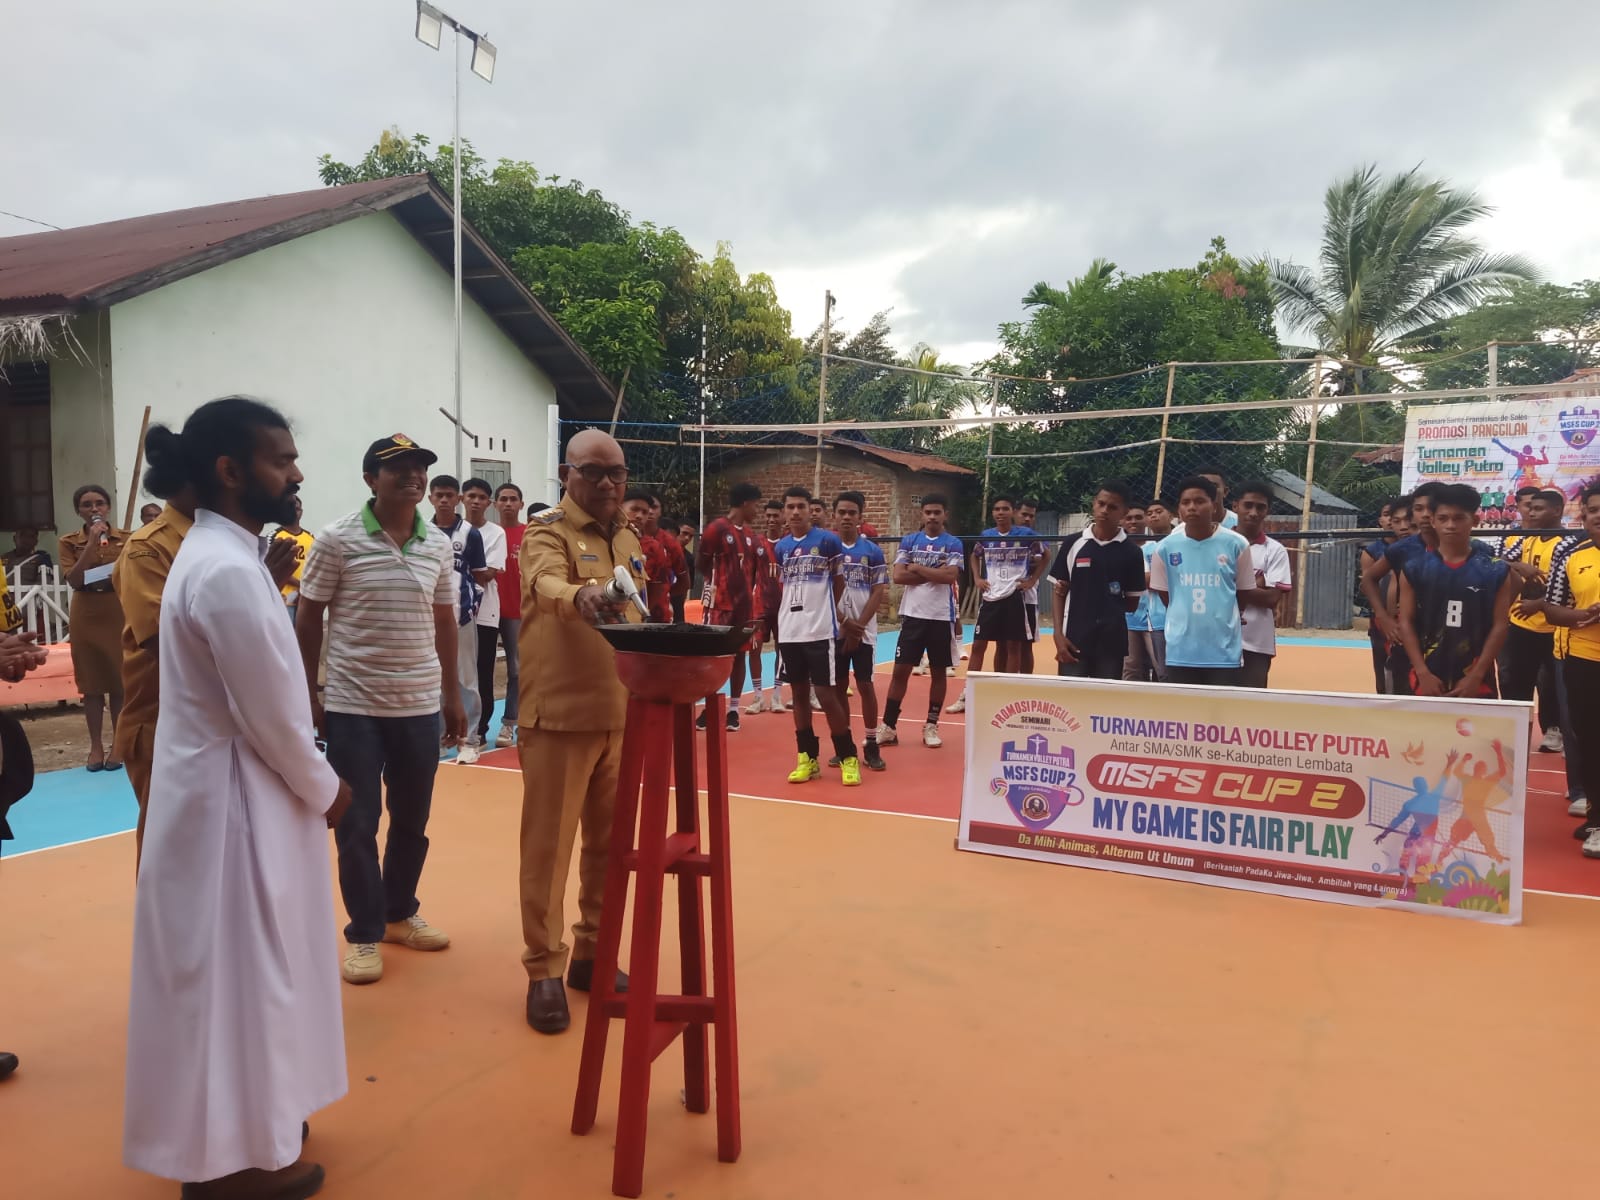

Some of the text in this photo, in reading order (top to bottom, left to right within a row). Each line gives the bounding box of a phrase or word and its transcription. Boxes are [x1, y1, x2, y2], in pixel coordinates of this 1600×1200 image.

[1418, 423, 1527, 439] PROMOSI PANGGILAN
[1581, 420, 1595, 428] CUP
[1418, 446, 1486, 459] Turnamen
[1418, 459, 1504, 476] Volley Putra
[1192, 588, 1206, 613] 8
[1446, 600, 1463, 627] 8
[991, 700, 1080, 731] PROMOSI PANGGILAN
[1020, 715, 1051, 725] SEMINARI
[1090, 715, 1390, 759] TURNAMEN BOLA VOLLEY PUTRA
[1110, 738, 1353, 773] Antar SMA/SMK se-Kabupaten Lembata
[1003, 765, 1076, 787] MSFS CUP 2
[1212, 772, 1303, 803] CUP
[1310, 782, 1346, 810] 2
[1092, 797, 1354, 860] MY GAME IS FAIR PLAY
[1018, 833, 1194, 867] Da Mihi Animas, Alterum Ut Unum
[1353, 882, 1372, 892] yang
